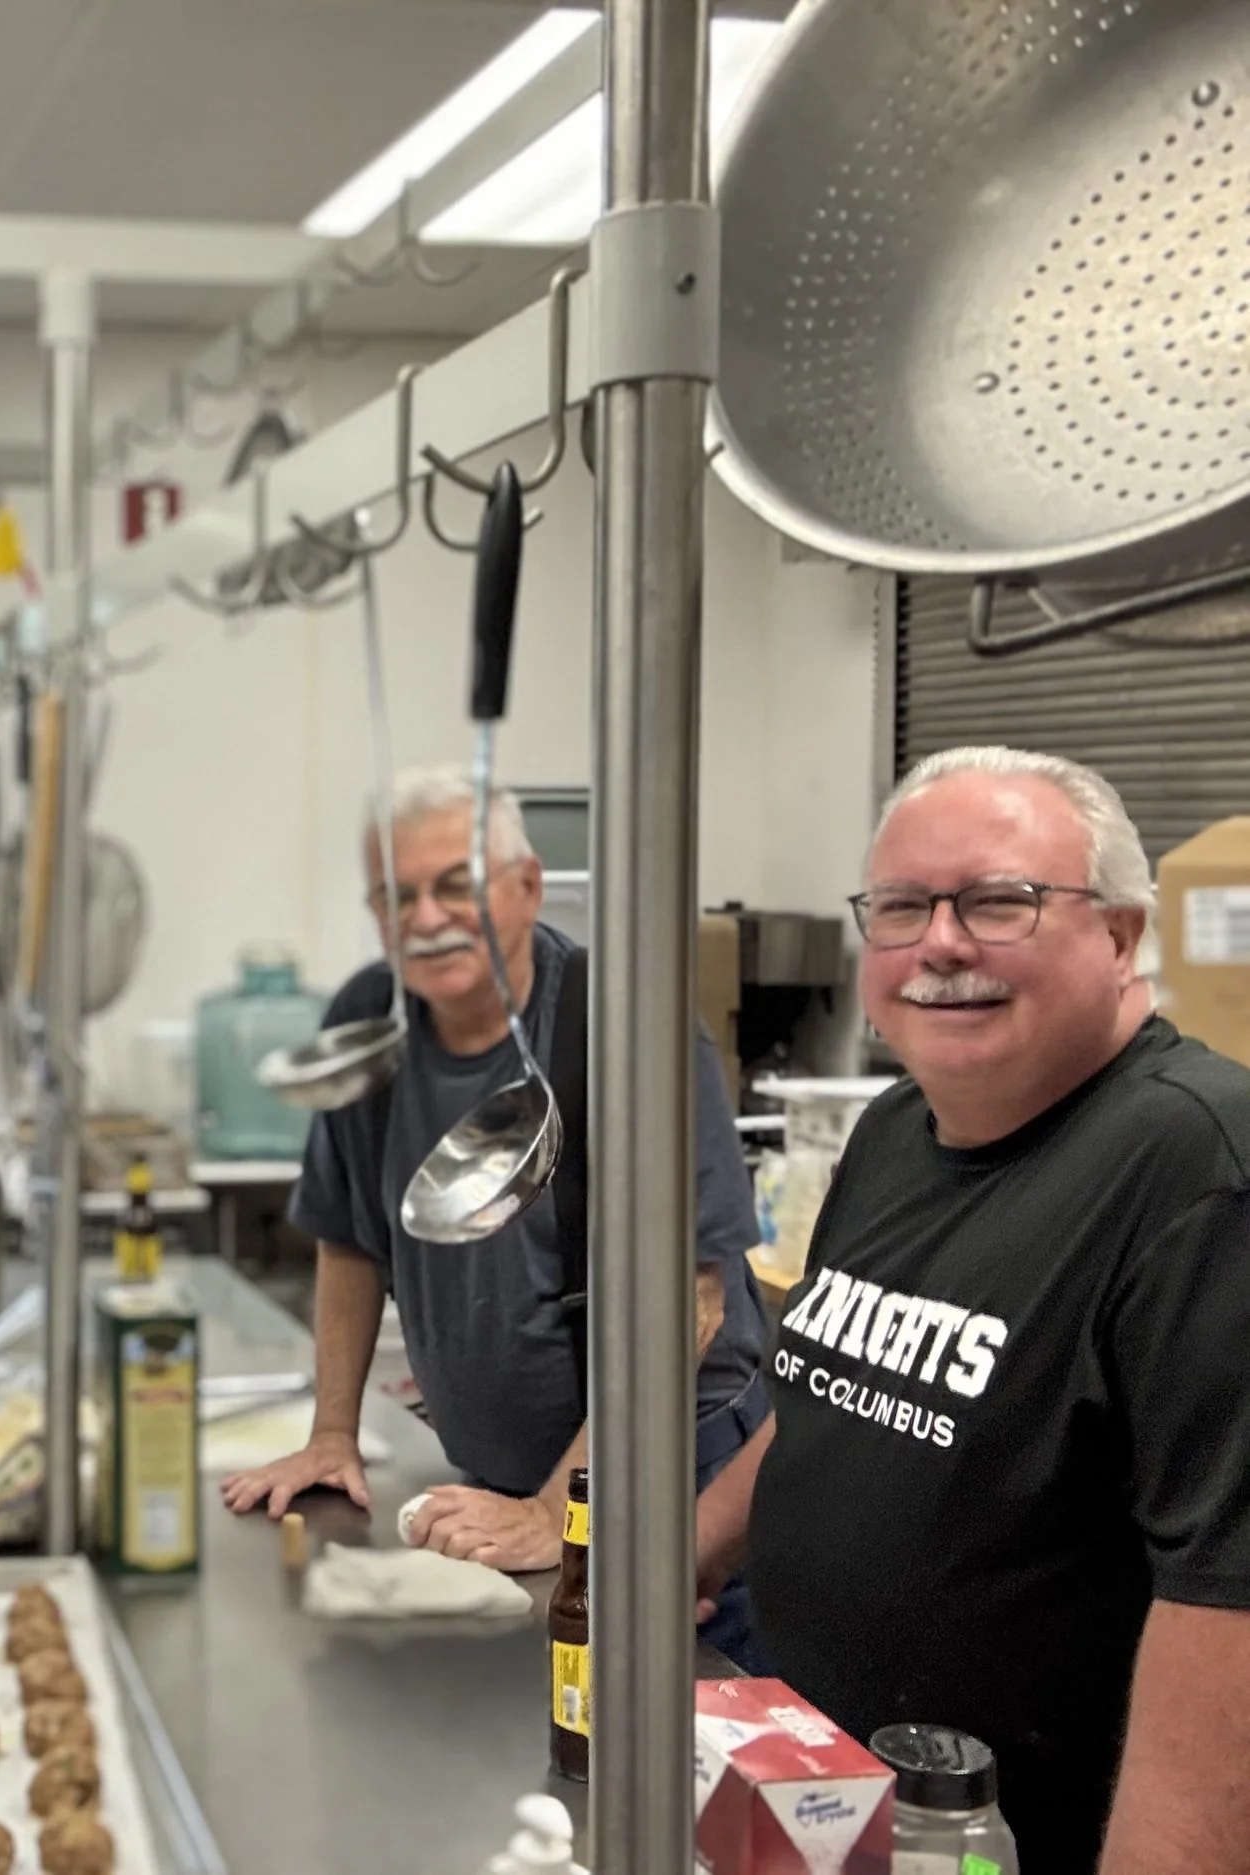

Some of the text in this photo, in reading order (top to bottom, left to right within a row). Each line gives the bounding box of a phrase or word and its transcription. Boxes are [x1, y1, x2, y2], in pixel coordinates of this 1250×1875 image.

[782, 1266, 1009, 1398] KNIGHTS
[775, 1349, 956, 1448] OF COLUMBUS
